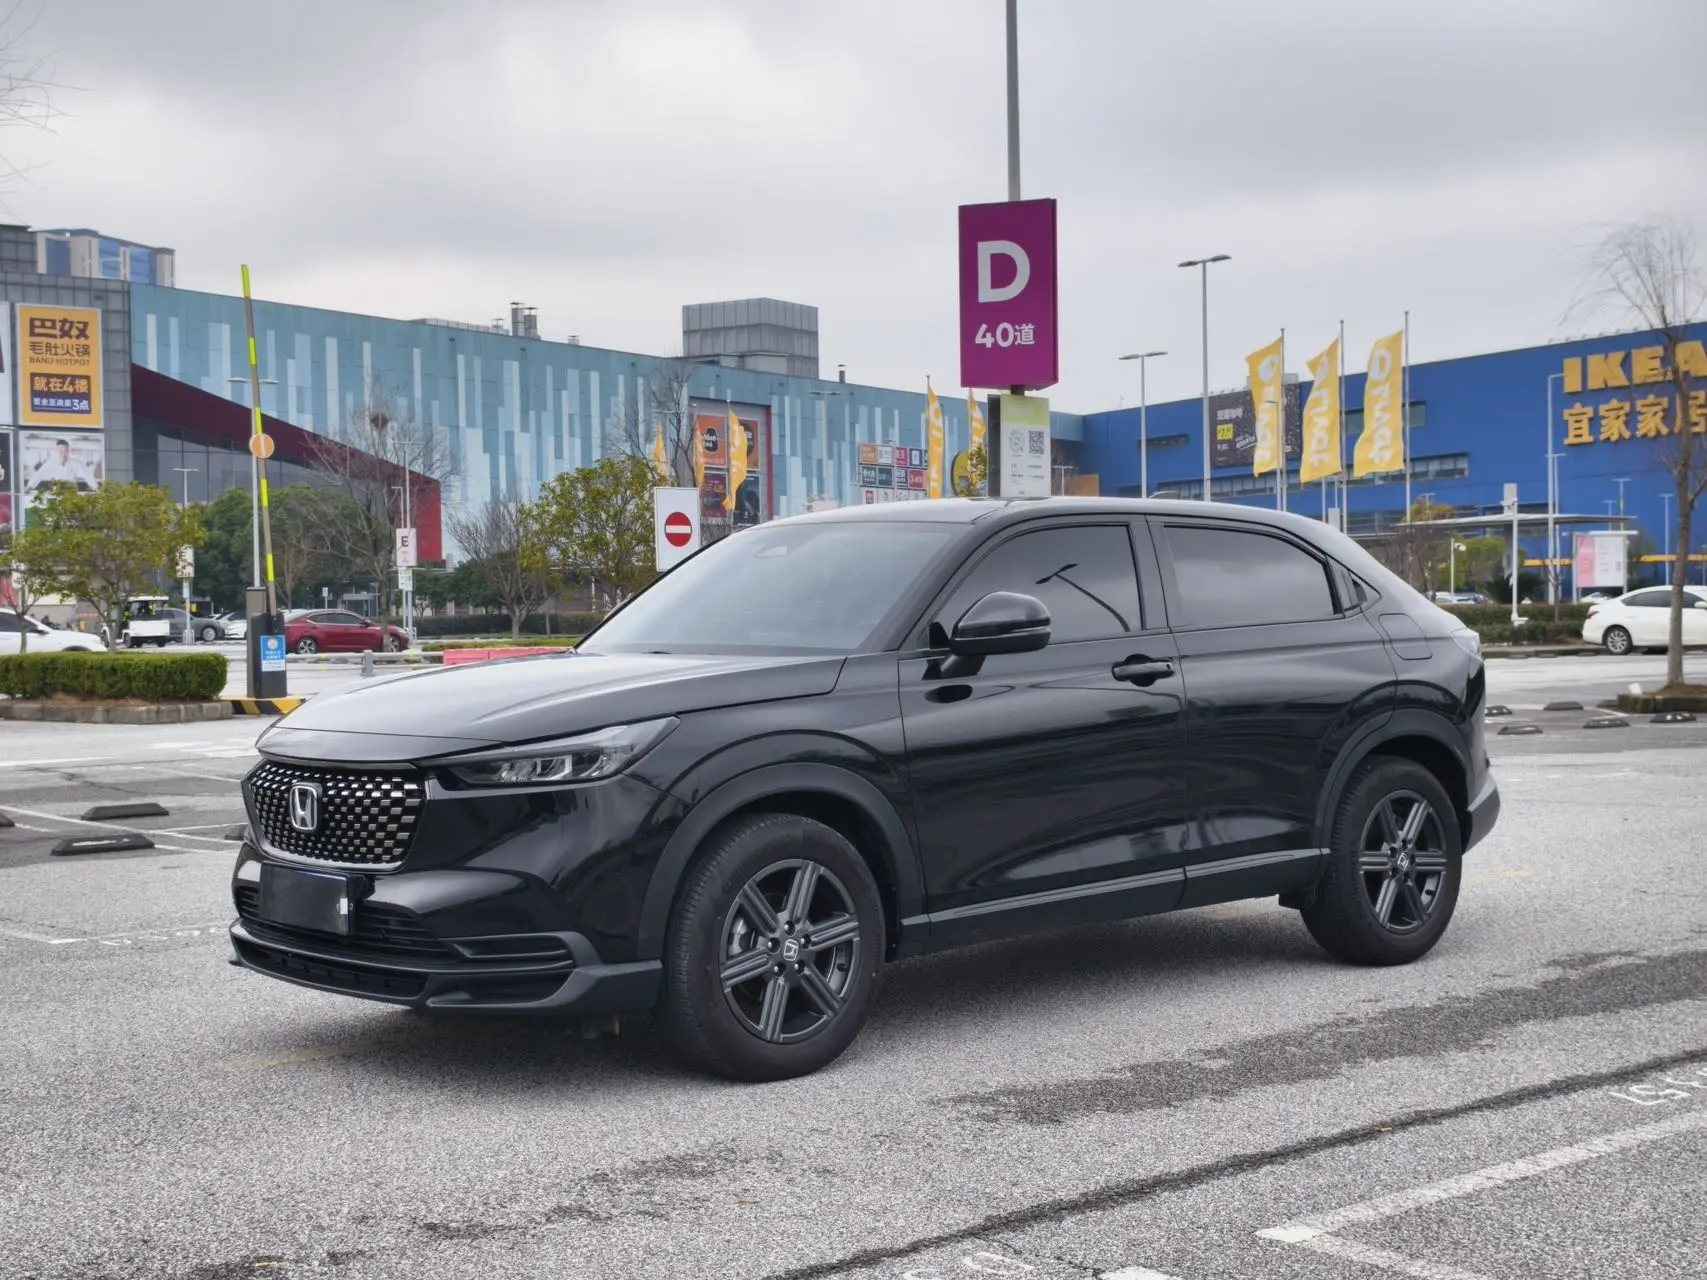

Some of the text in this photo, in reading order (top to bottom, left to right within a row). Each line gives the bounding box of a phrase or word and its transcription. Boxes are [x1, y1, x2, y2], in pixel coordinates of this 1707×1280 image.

[977, 240, 1031, 303] D
[29, 317, 90, 340] 巴奴
[975, 321, 1036, 348] 40道
[29, 341, 90, 358] 毛肚火锅
[1563, 340, 1707, 394] IKEA
[33, 376, 89, 394] 就在4楼
